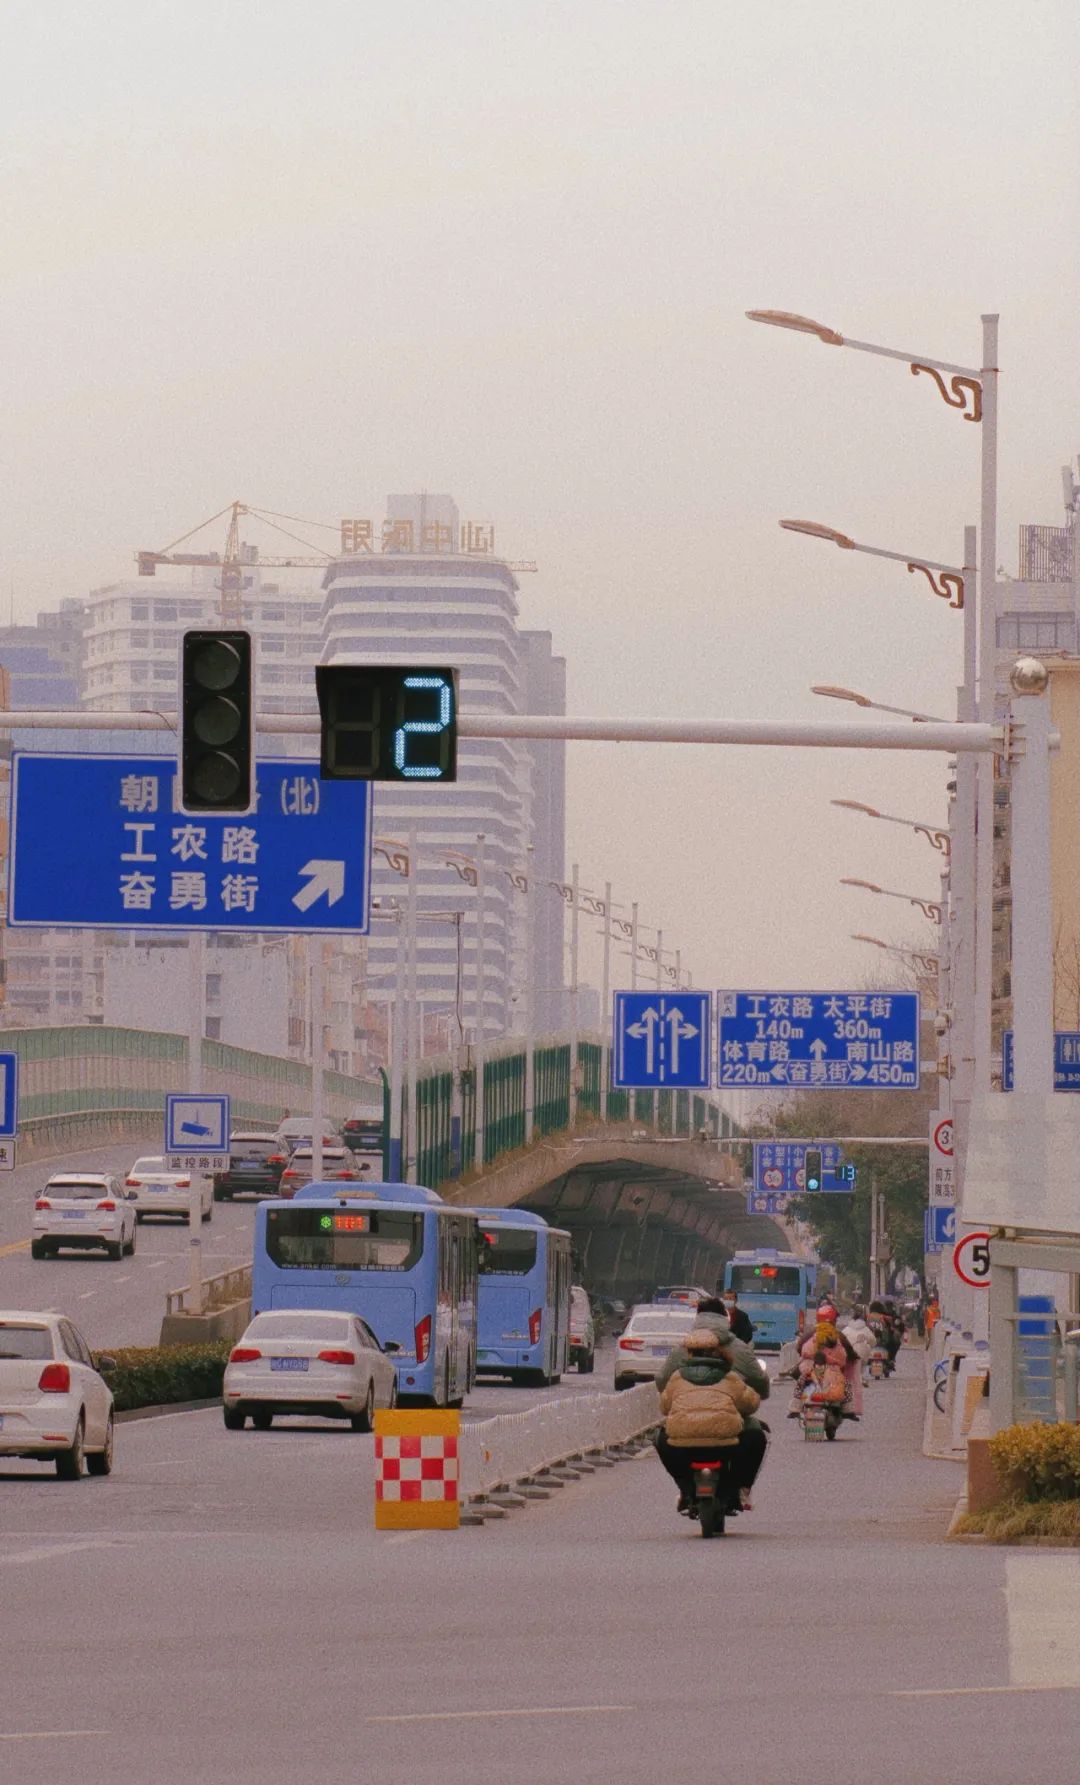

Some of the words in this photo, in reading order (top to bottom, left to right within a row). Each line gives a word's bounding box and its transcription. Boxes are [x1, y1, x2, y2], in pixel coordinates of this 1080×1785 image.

[340, 519, 495, 553] 银河中心
[394, 676, 451, 778] 2
[119, 773, 320, 816] 朝(北)
[120, 823, 260, 864] 工农路
[119, 871, 259, 912] 奋勇街
[745, 995, 814, 1019] 工农路
[823, 995, 892, 1019] 太平街
[755, 1019, 804, 1039] 140m
[833, 1019, 882, 1039] 360m
[723, 1040, 790, 1062] 体育路
[847, 1040, 914, 1062] 南山路
[722, 1063, 770, 1083] 220m
[790, 1062, 848, 1082] 奋勇街
[867, 1063, 915, 1083] 450m
[171, 1156, 223, 1168] 监控路段
[842, 1165, 855, 1180] 13
